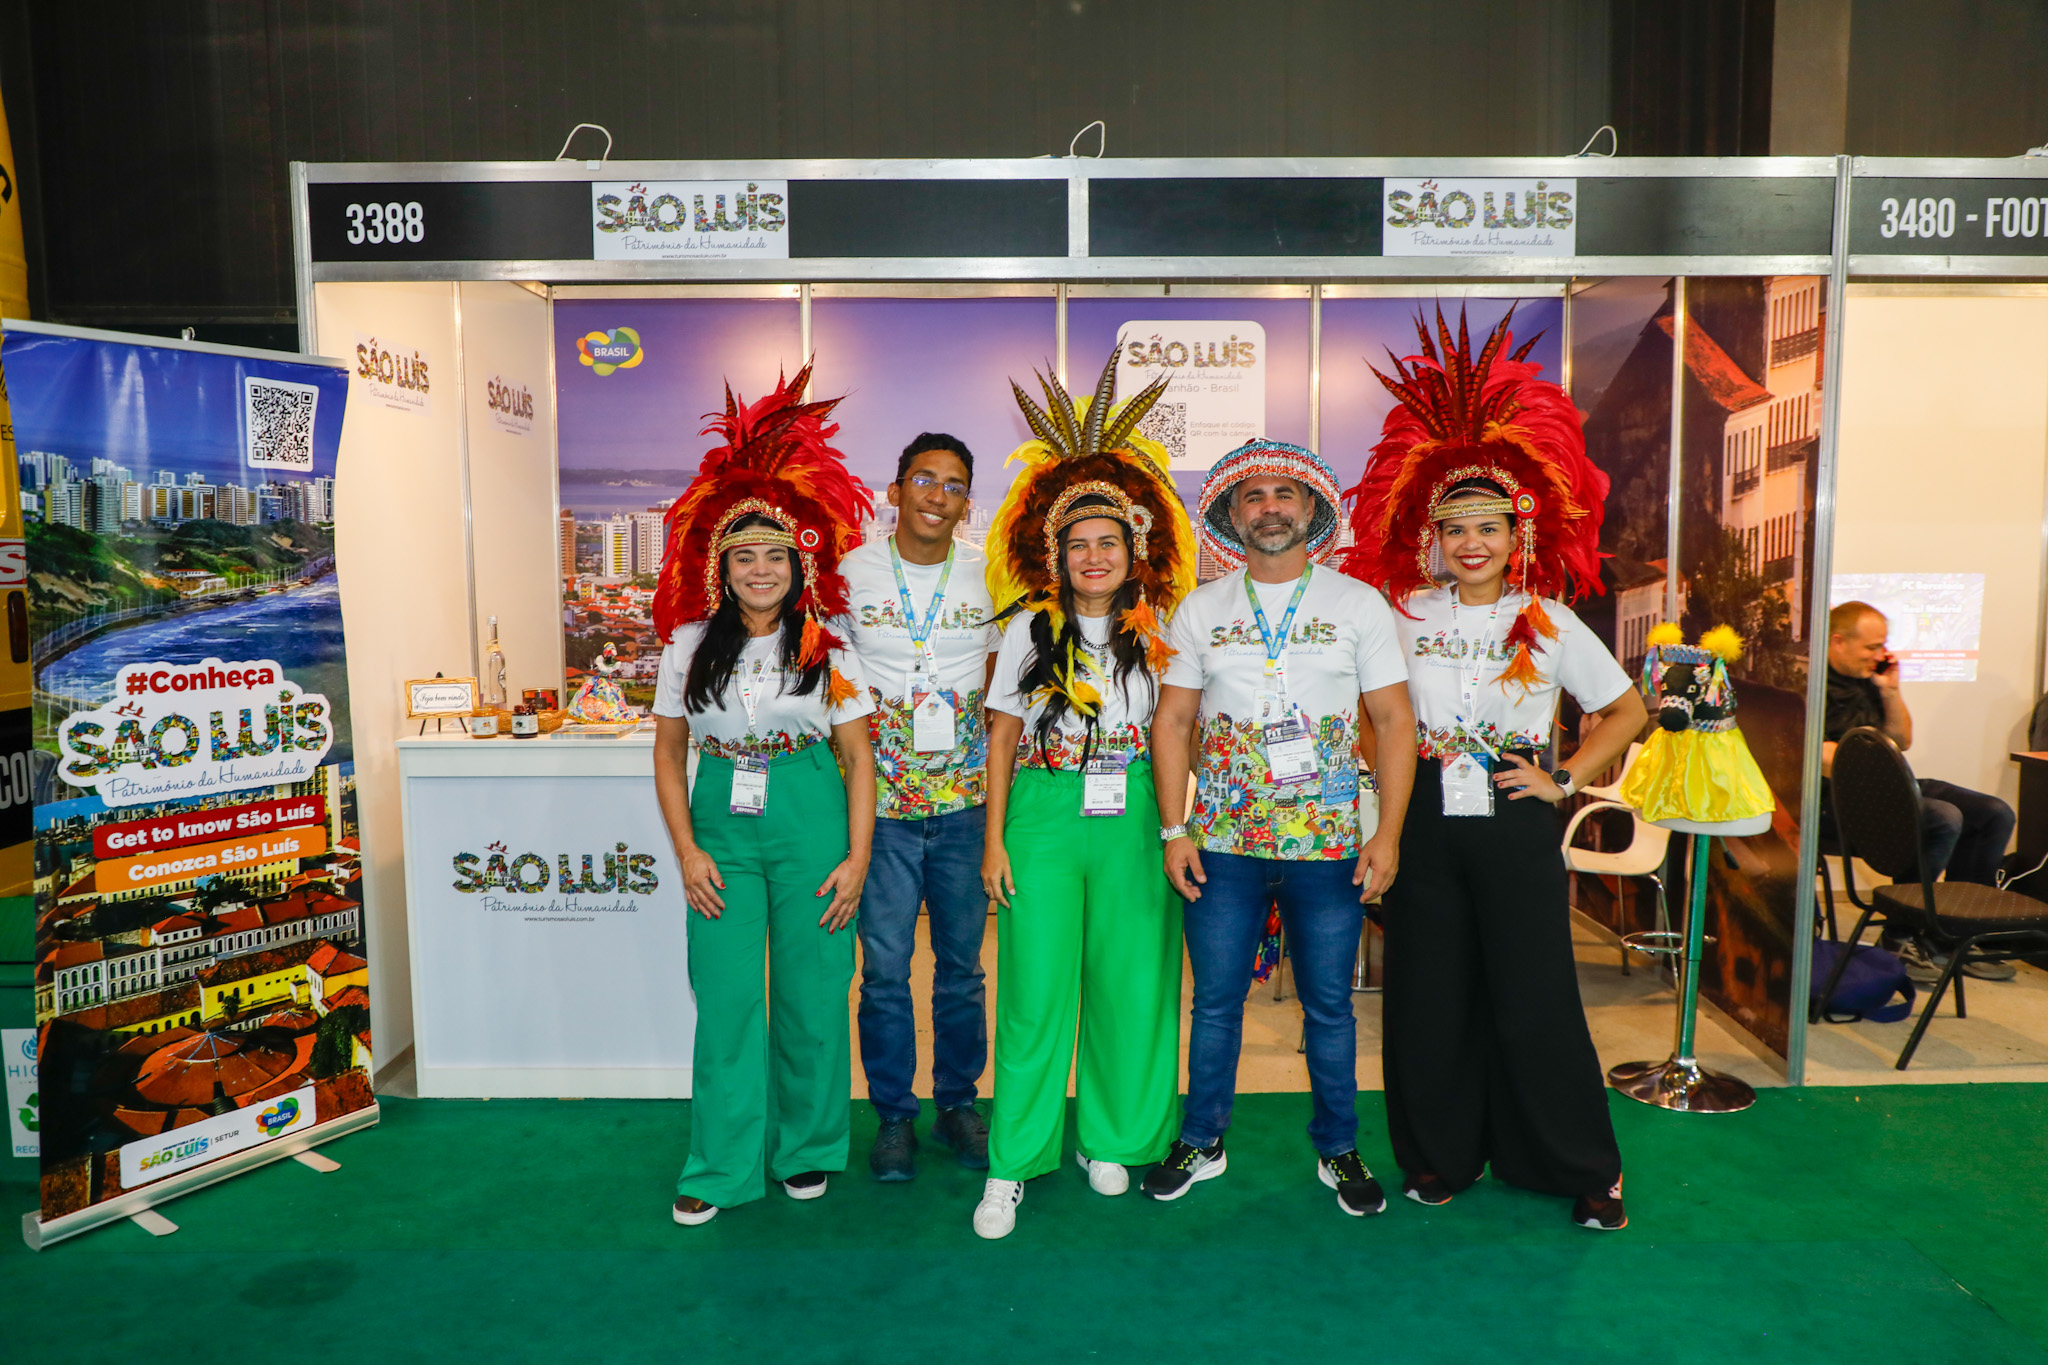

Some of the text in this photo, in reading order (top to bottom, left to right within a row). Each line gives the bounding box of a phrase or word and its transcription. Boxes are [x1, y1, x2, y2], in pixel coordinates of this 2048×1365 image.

[346, 201, 425, 245] 3388
[1880, 197, 1956, 239] 3480
[684, 237, 698, 250] da
[700, 235, 767, 250] Humanidade
[1472, 233, 1487, 246] da
[1488, 231, 1554, 246] Humanidade
[594, 347, 630, 357] BRASIL
[1167, 384, 1200, 393] anhão
[1210, 383, 1239, 393] Brasil
[126, 666, 275, 695] #Conheça
[198, 771, 217, 788] da
[219, 759, 307, 784] Humanidade
[107, 803, 316, 850] Get to know São Luís
[128, 837, 300, 882] Conozca São Luís
[548, 899, 564, 912] da
[566, 896, 639, 912] Humanidade
[267, 1111, 293, 1126] BRASIL
[139, 1149, 173, 1172] SÃO
[176, 1135, 209, 1159] LUÍS
[214, 1129, 240, 1144] SETUR
